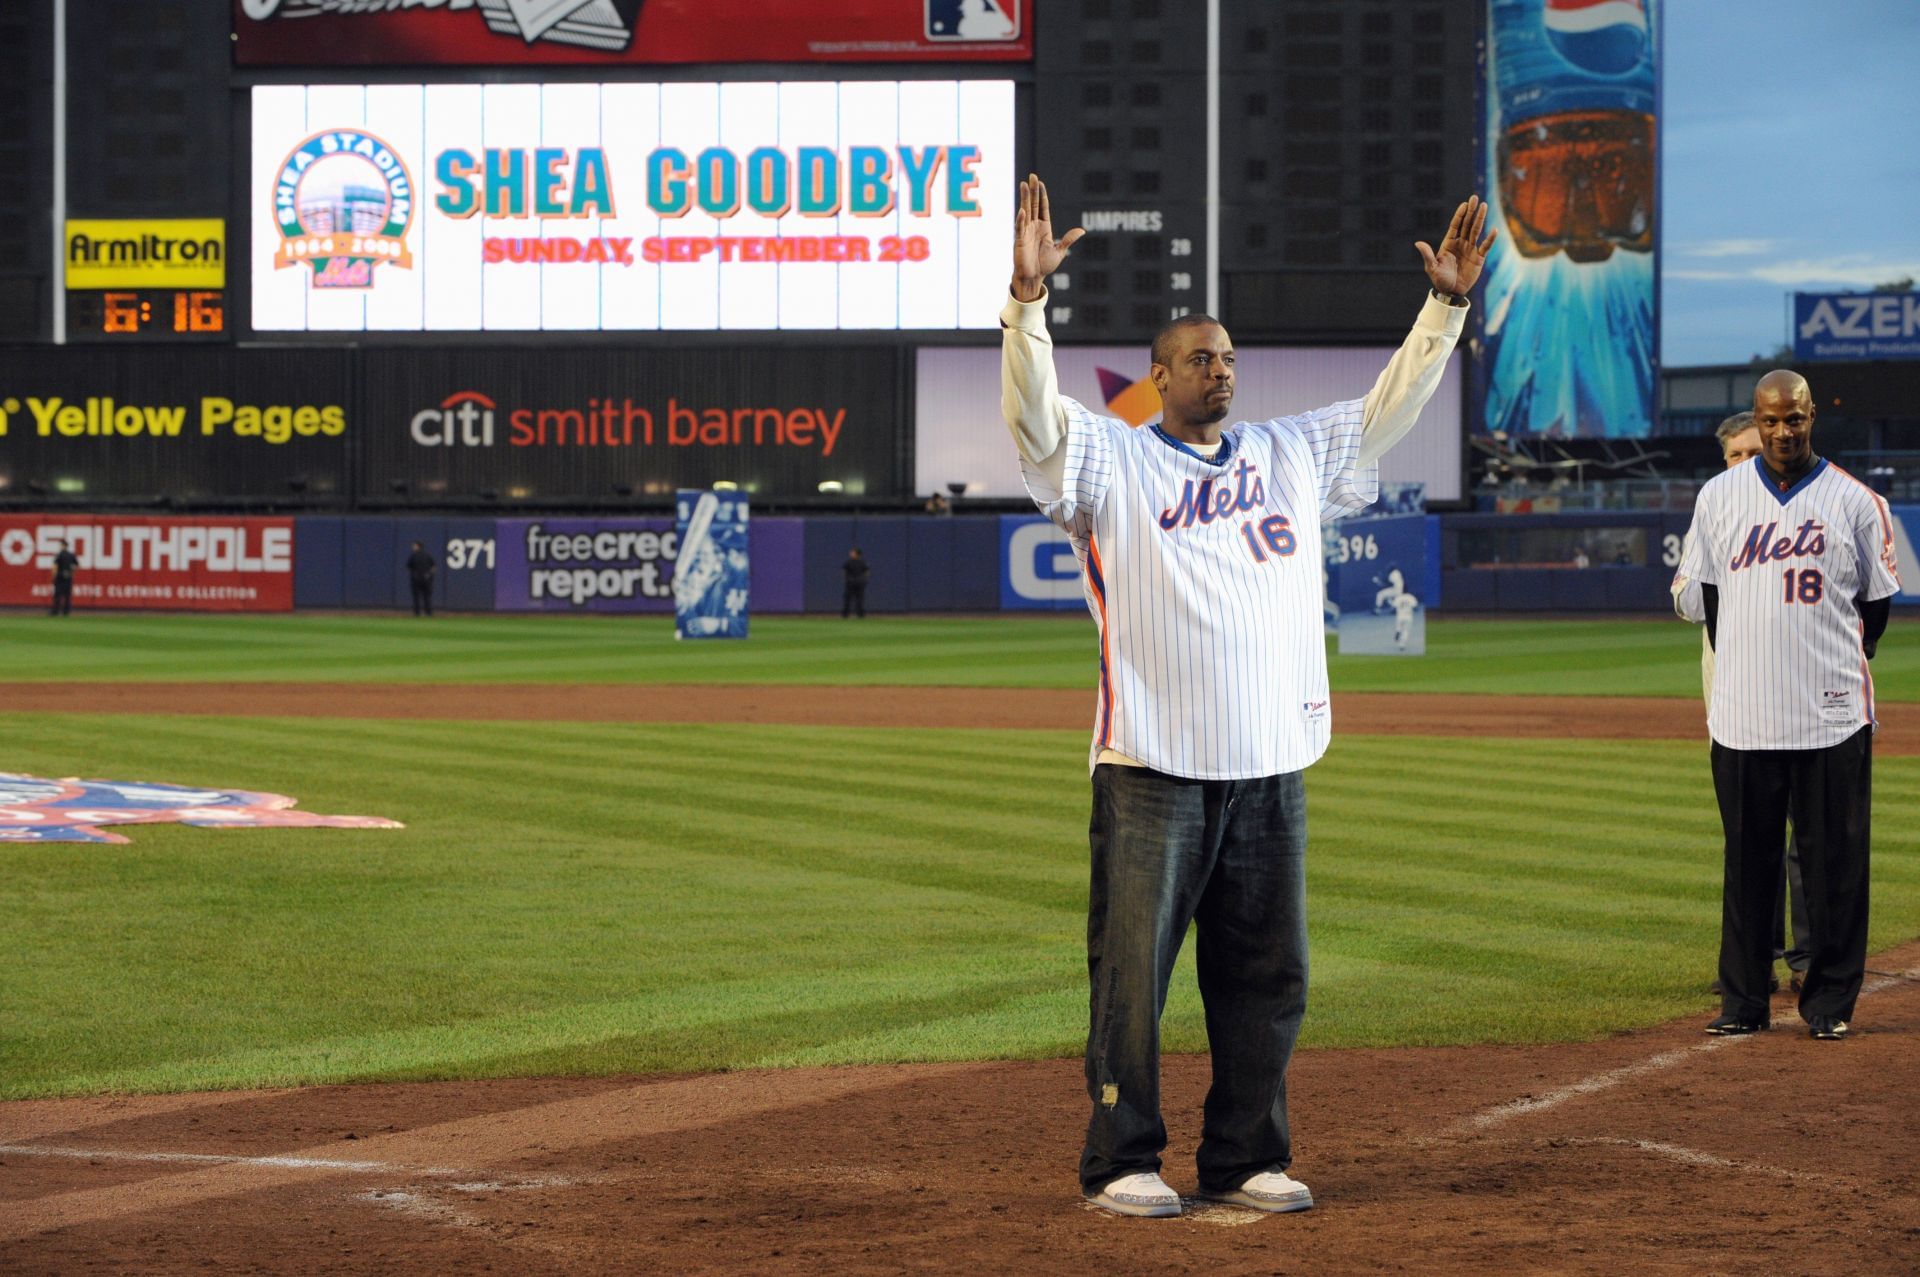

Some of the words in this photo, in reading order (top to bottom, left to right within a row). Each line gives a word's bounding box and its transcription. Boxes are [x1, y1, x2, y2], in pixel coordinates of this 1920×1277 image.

[277, 150, 315, 225] SHEA
[320, 132, 409, 225] STADIUM
[435, 147, 616, 219] SHEA
[646, 146, 982, 218] GOODBYE
[1081, 211, 1163, 231] UMPIRES
[70, 234, 221, 262] Armitron
[483, 237, 634, 267] SUNDAY,
[642, 236, 871, 263] SEPTEMBER
[878, 235, 931, 262] 28
[1814, 342, 1866, 356] Building
[26, 397, 186, 436] Yellow
[201, 397, 346, 444] Pages
[410, 400, 495, 446] citi
[509, 399, 653, 446] smith
[667, 399, 846, 456] barney
[1159, 458, 1265, 532] Mets
[36, 525, 292, 572] SOUTHPOLE
[447, 539, 495, 569] 371
[1241, 514, 1298, 563] 16
[1329, 534, 1379, 564] 396
[1662, 534, 1687, 567] 3
[1731, 519, 1826, 571] Mets
[32, 584, 101, 596] AUTNTIC
[107, 585, 172, 598] CLOTHING
[177, 586, 257, 599] COLLECTION
[1783, 568, 1823, 606] 18
